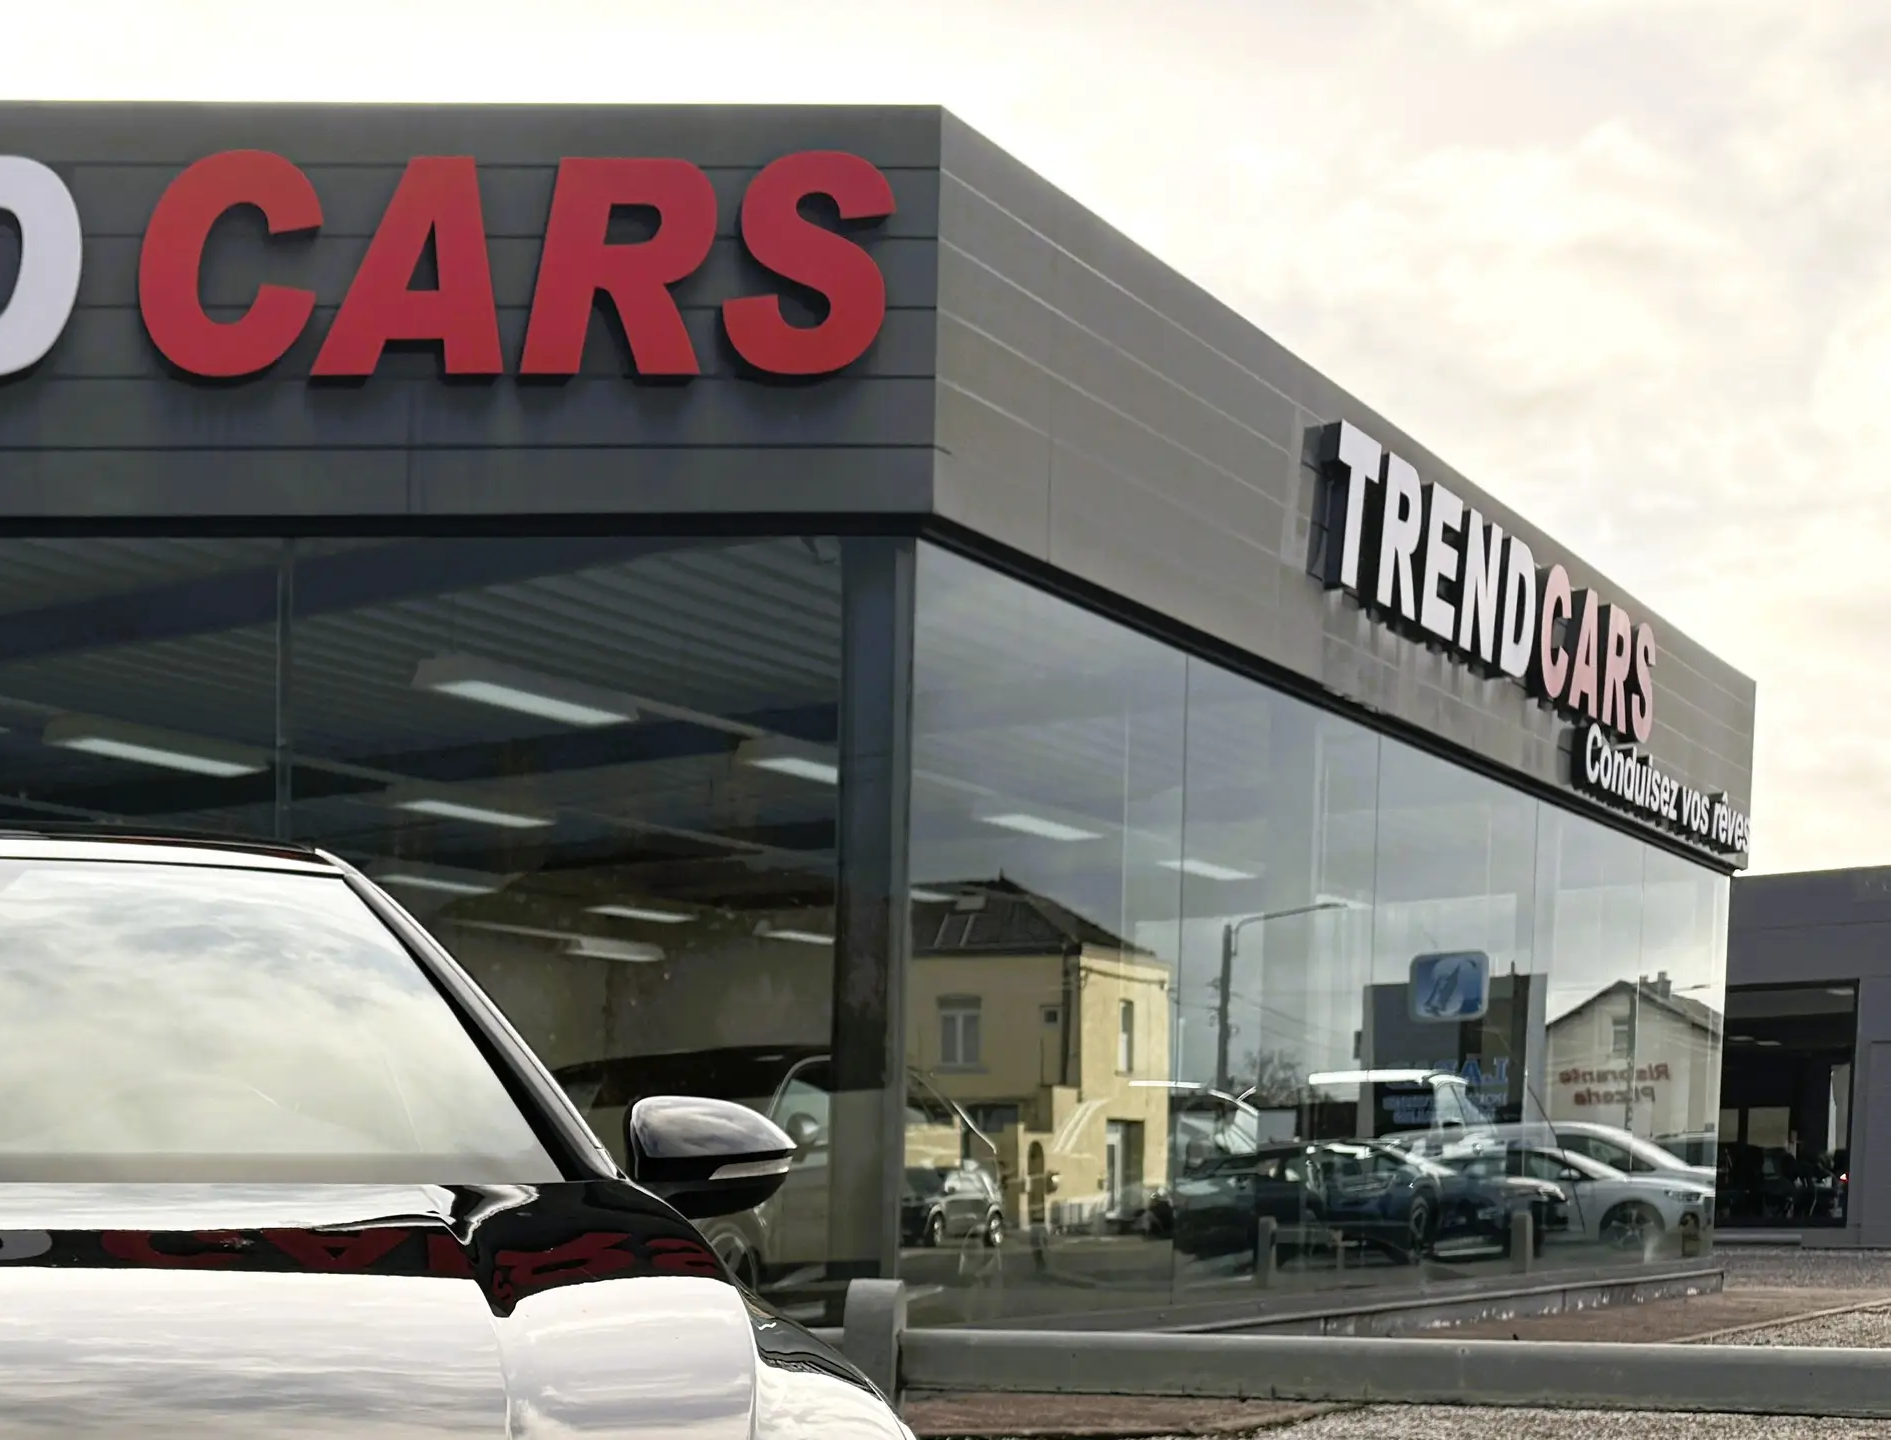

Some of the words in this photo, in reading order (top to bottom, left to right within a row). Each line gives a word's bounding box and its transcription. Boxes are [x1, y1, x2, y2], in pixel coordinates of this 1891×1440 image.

[138, 149, 896, 377] CARS
[1338, 419, 1536, 678] TREND
[1541, 564, 1656, 742] CARS
[1586, 722, 1680, 820] Conduisez
[1682, 784, 1709, 835] vos
[1711, 790, 1751, 854] rêves
